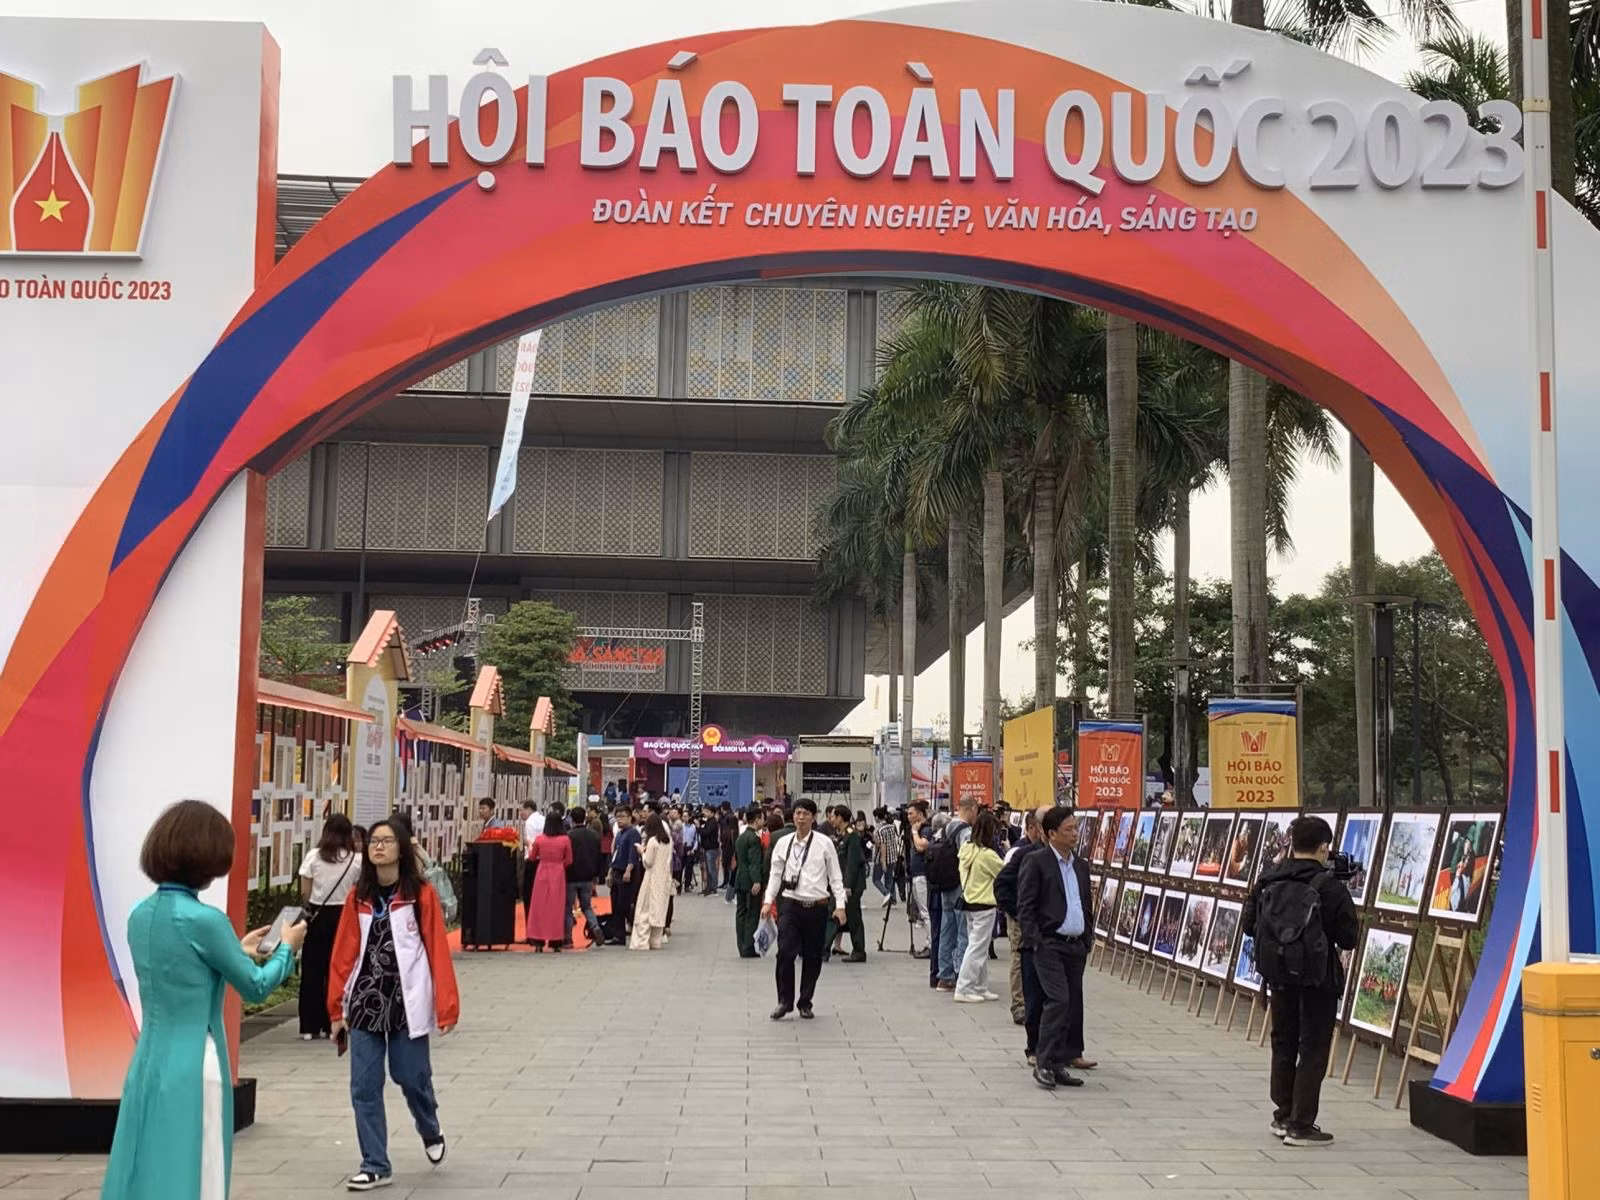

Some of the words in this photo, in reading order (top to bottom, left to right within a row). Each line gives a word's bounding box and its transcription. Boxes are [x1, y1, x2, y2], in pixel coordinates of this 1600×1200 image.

[392, 47, 548, 192] HỘI
[580, 51, 760, 174] BÁO
[783, 61, 1016, 181] TOÀN
[1045, 60, 1286, 195] QUỐC
[1309, 99, 1524, 190] 2023
[592, 188, 673, 225] ĐOÀN
[679, 183, 734, 226] KẾT
[745, 197, 857, 229] CHUYÊN
[864, 199, 976, 234] NGHIỆP,
[984, 197, 1040, 231] VĂN
[1046, 196, 1112, 236] HÓA,
[1119, 194, 1197, 231] SÁNG
[1203, 205, 1258, 237] TẠO
[15, 274, 66, 299] TOÀN
[71, 272, 124, 299] QUỐC
[127, 280, 172, 300] 2023
[1227, 759, 1251, 774] HỘI
[1254, 759, 1282, 772] BÁO
[1225, 774, 1253, 785] TOÀN
[1095, 787, 1123, 797] 2023
[1236, 790, 1275, 803] 2023
